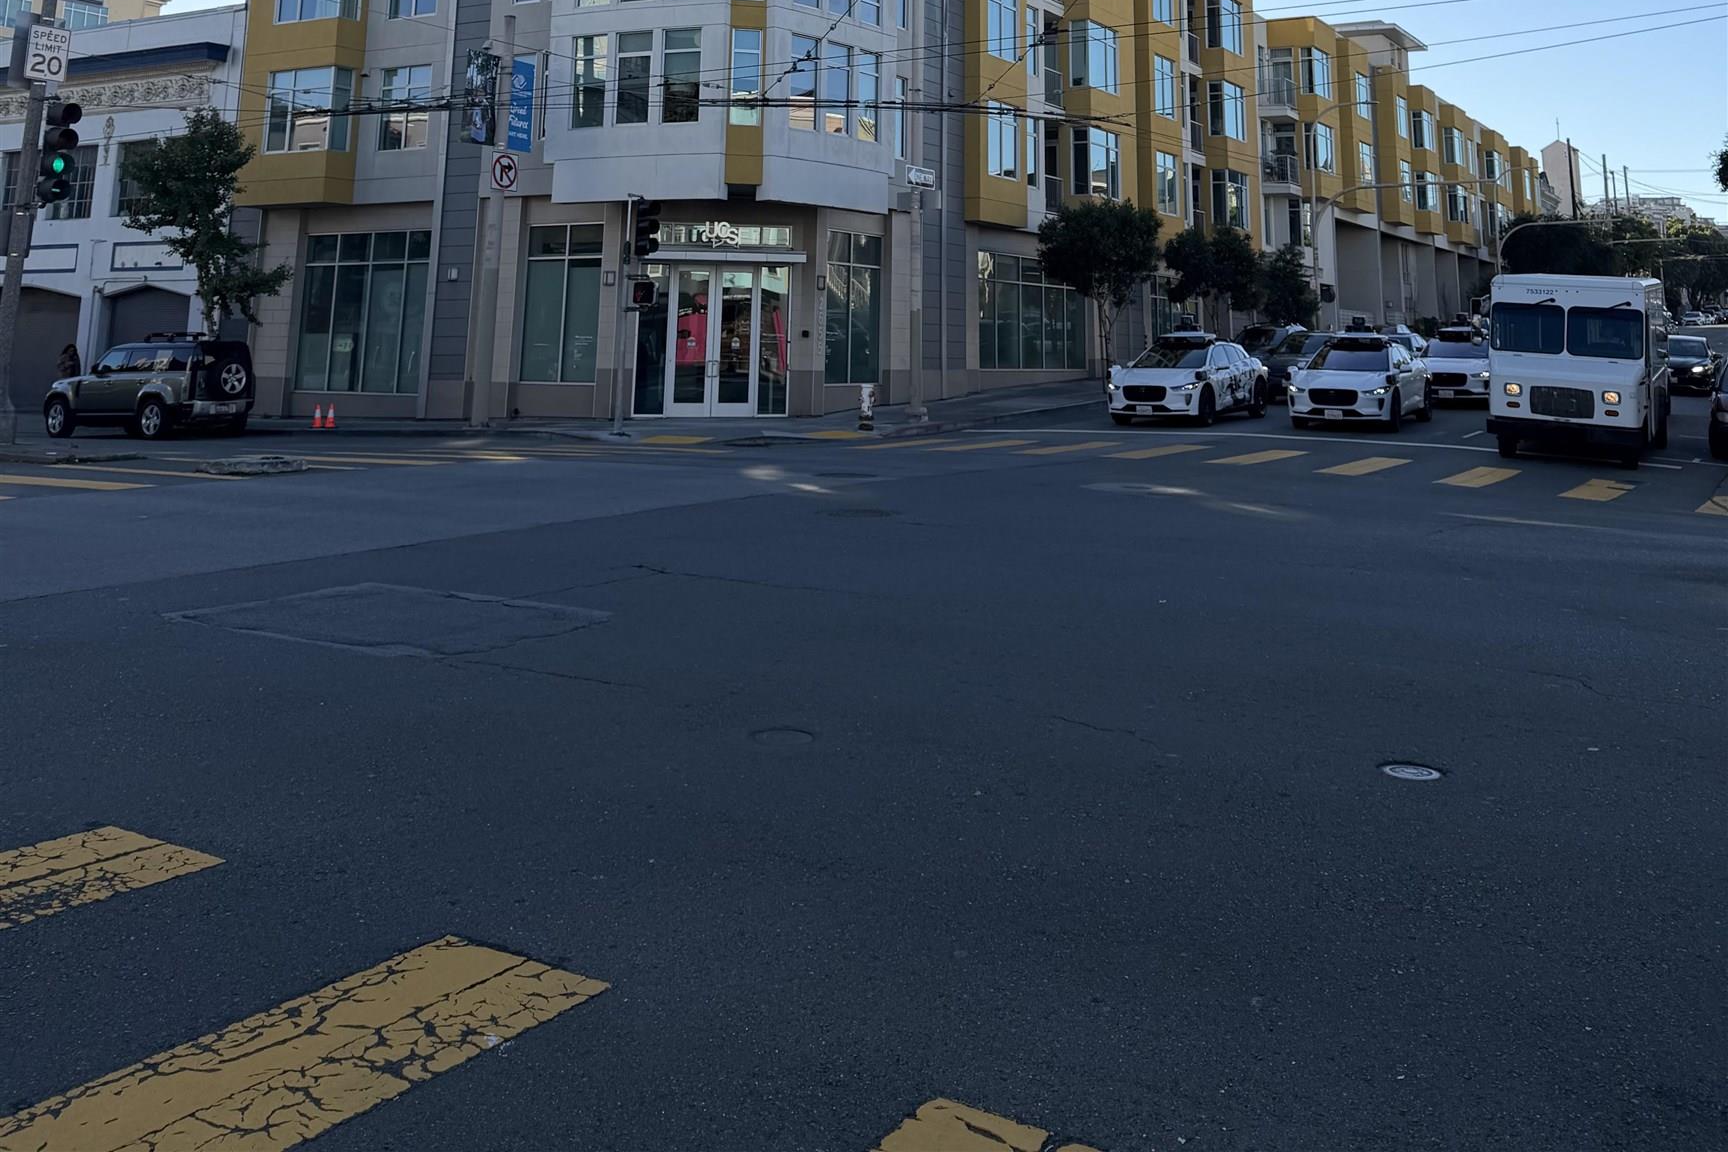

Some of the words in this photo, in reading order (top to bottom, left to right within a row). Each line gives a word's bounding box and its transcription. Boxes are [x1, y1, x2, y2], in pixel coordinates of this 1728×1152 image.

[33, 30, 67, 44] SPEED
[35, 41, 63, 54] LIMIT
[30, 53, 63, 76] 20
